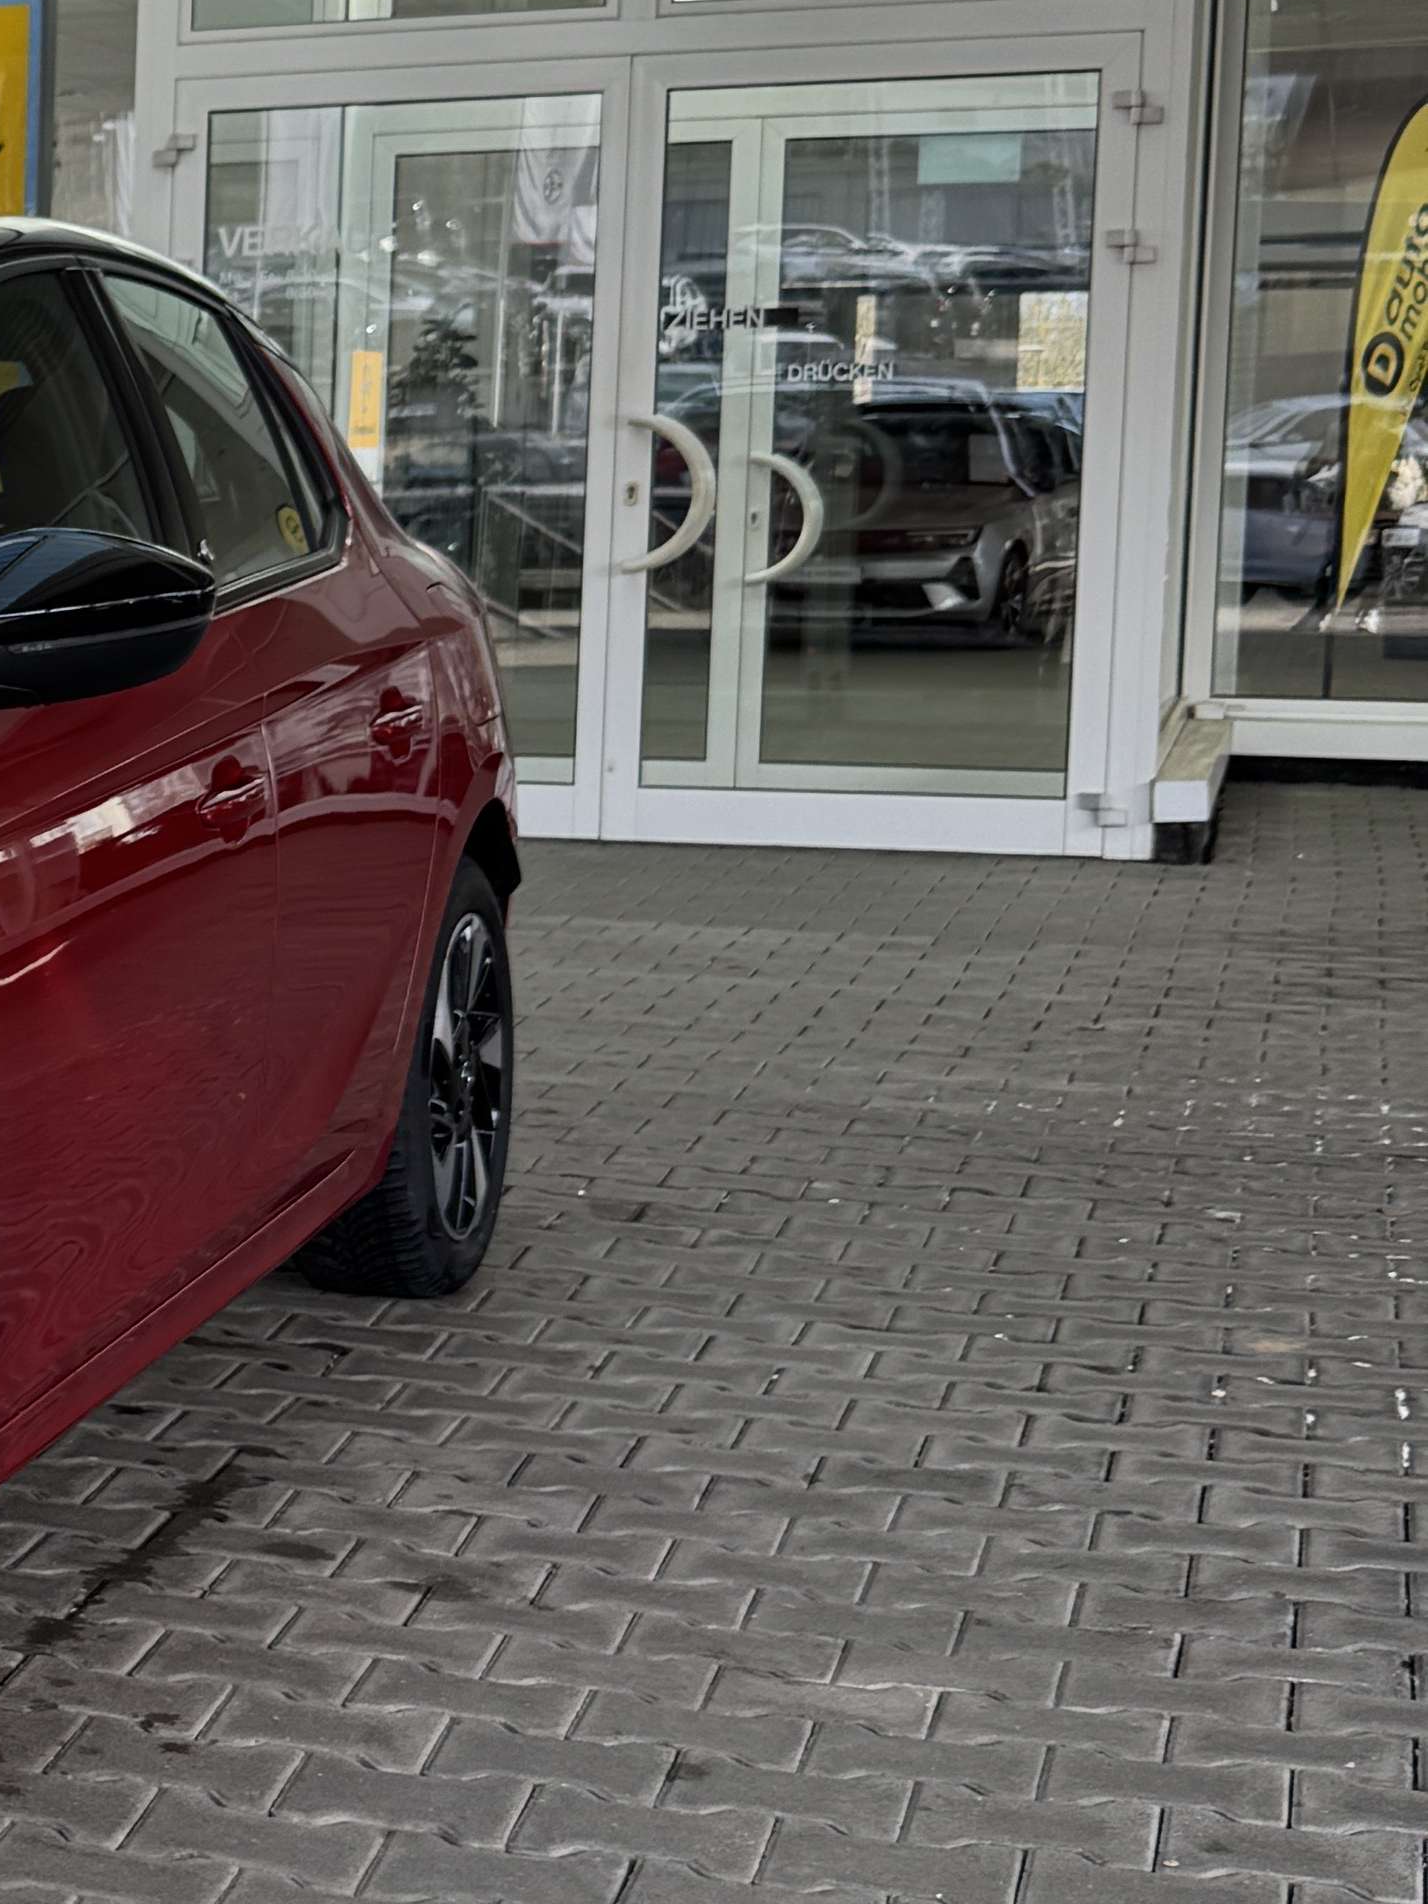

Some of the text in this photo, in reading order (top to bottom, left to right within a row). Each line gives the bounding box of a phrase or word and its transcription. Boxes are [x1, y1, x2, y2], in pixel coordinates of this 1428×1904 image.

[668, 306, 765, 332] ZIEHEN
[787, 358, 894, 382] DRÜCKEN
[1367, 341, 1397, 388] D
